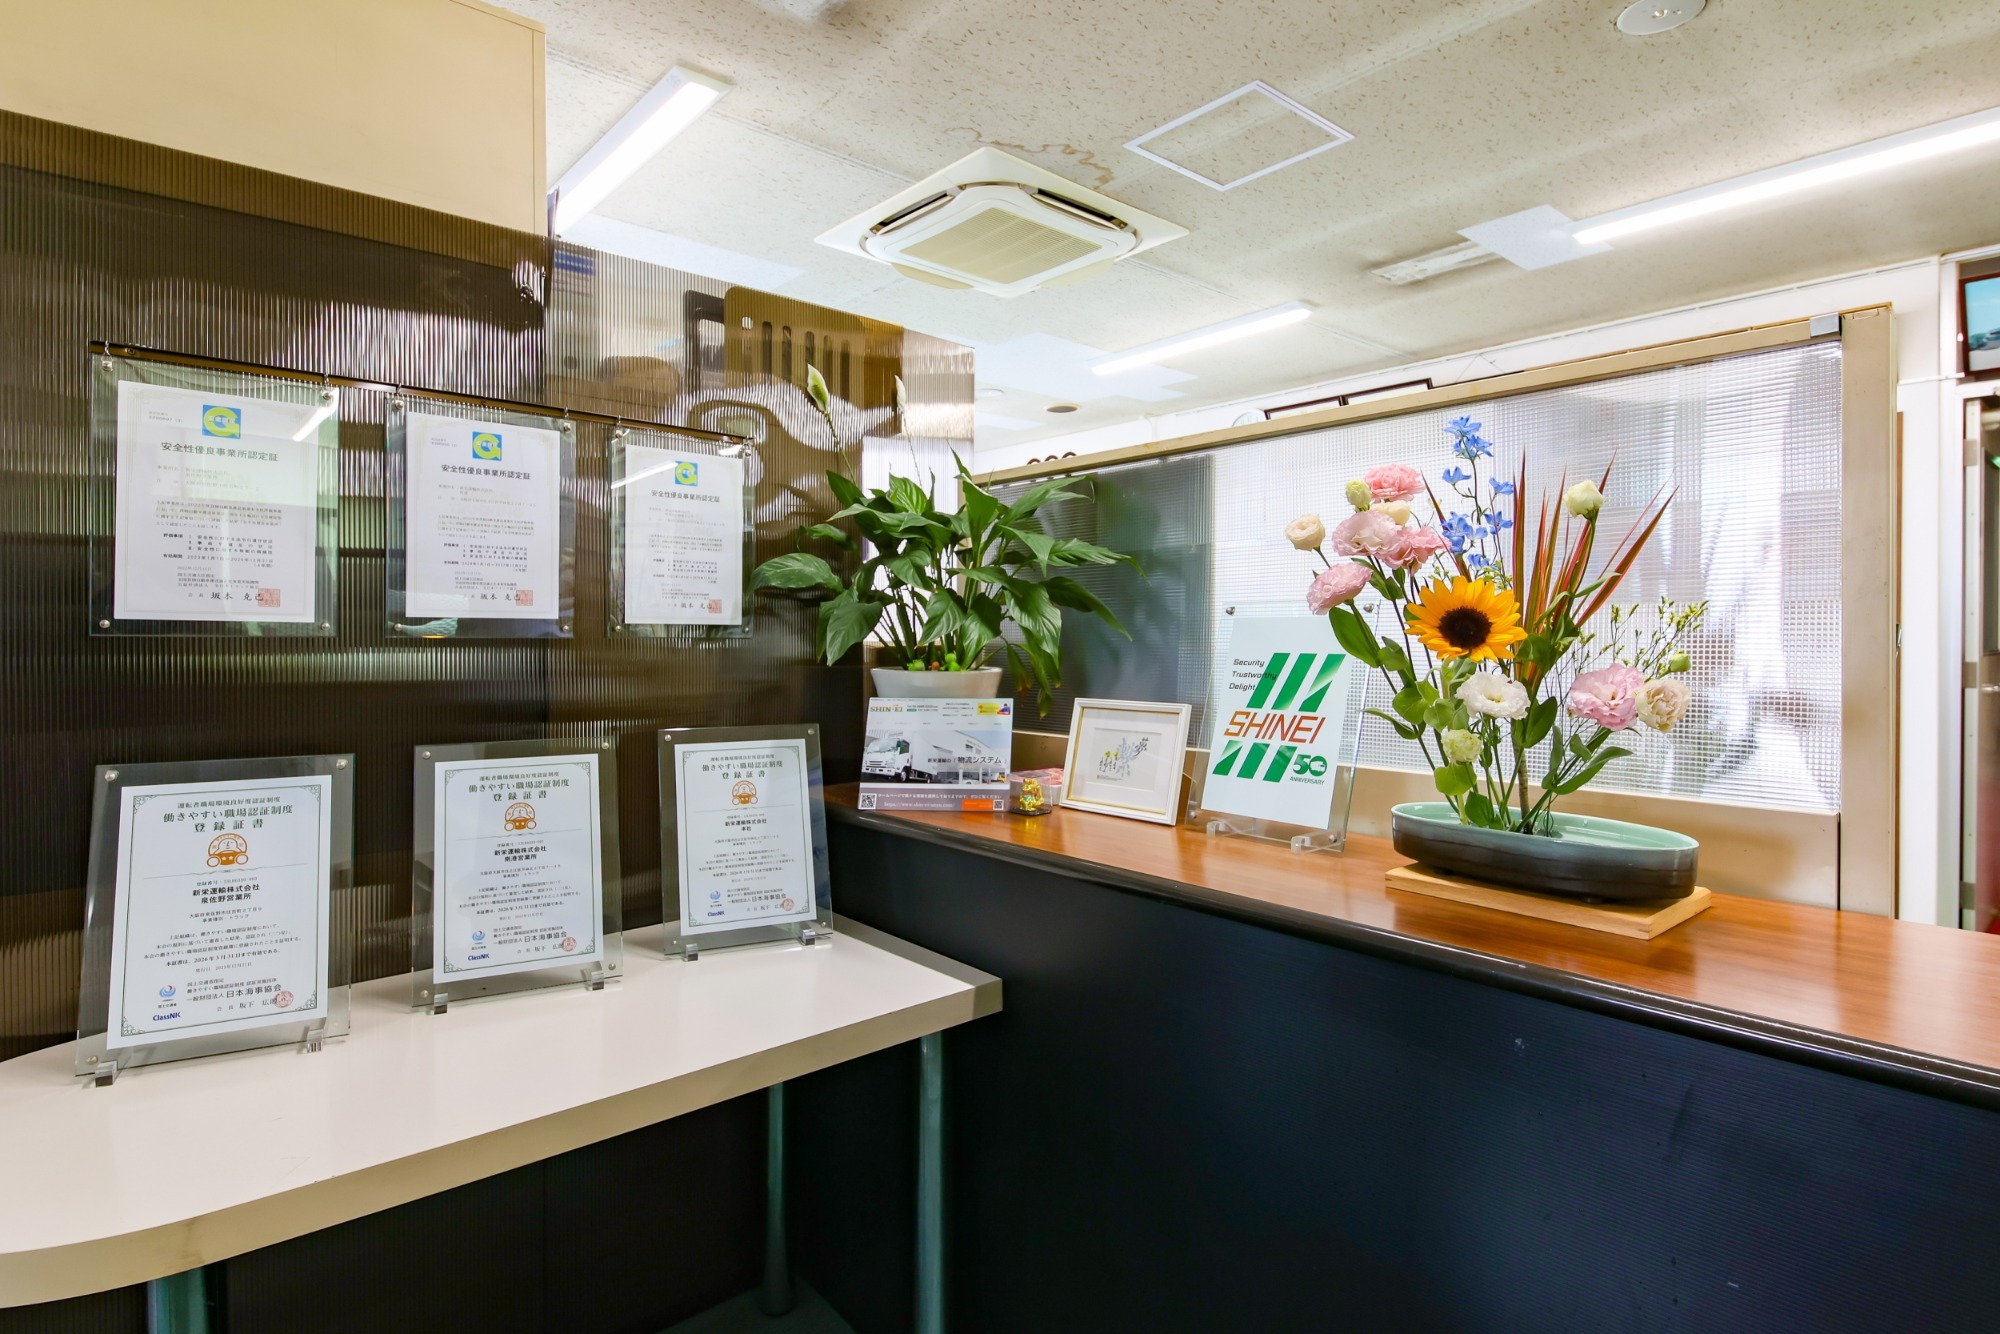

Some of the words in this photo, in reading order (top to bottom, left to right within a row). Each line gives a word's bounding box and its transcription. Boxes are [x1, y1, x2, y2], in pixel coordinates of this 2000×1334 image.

[161, 442, 278, 462] 安全性優良事業所認定証
[441, 464, 531, 480] 安全性優良事業所認定証
[651, 490, 720, 503] 安全性優良事業所認定証
[1233, 658, 1264, 668] Security
[1232, 670, 1278, 680] Trustworthy
[1229, 682, 1256, 692] Delight
[1224, 710, 1326, 744] SHINEI
[702, 760, 783, 772] 働きやすい職場認証制度
[468, 778, 570, 793] 働きやすい職場認証制度
[1290, 776, 1324, 786] ANNIVERSARY
[177, 796, 280, 809] 運転者職場環境良好度認証制度
[493, 790, 547, 802] 登録証書
[163, 804, 294, 822] 働きやすい職場認証制度
[193, 818, 264, 833] 登録証書
[494, 846, 546, 856] 新栄運輸株式会社
[192, 883, 260, 897] 新栄運輸株式会社
[201, 892, 252, 904] 泉佐野営業所
[226, 984, 282, 999] 日本海事協会
[152, 1011, 181, 1022] ClassNK
